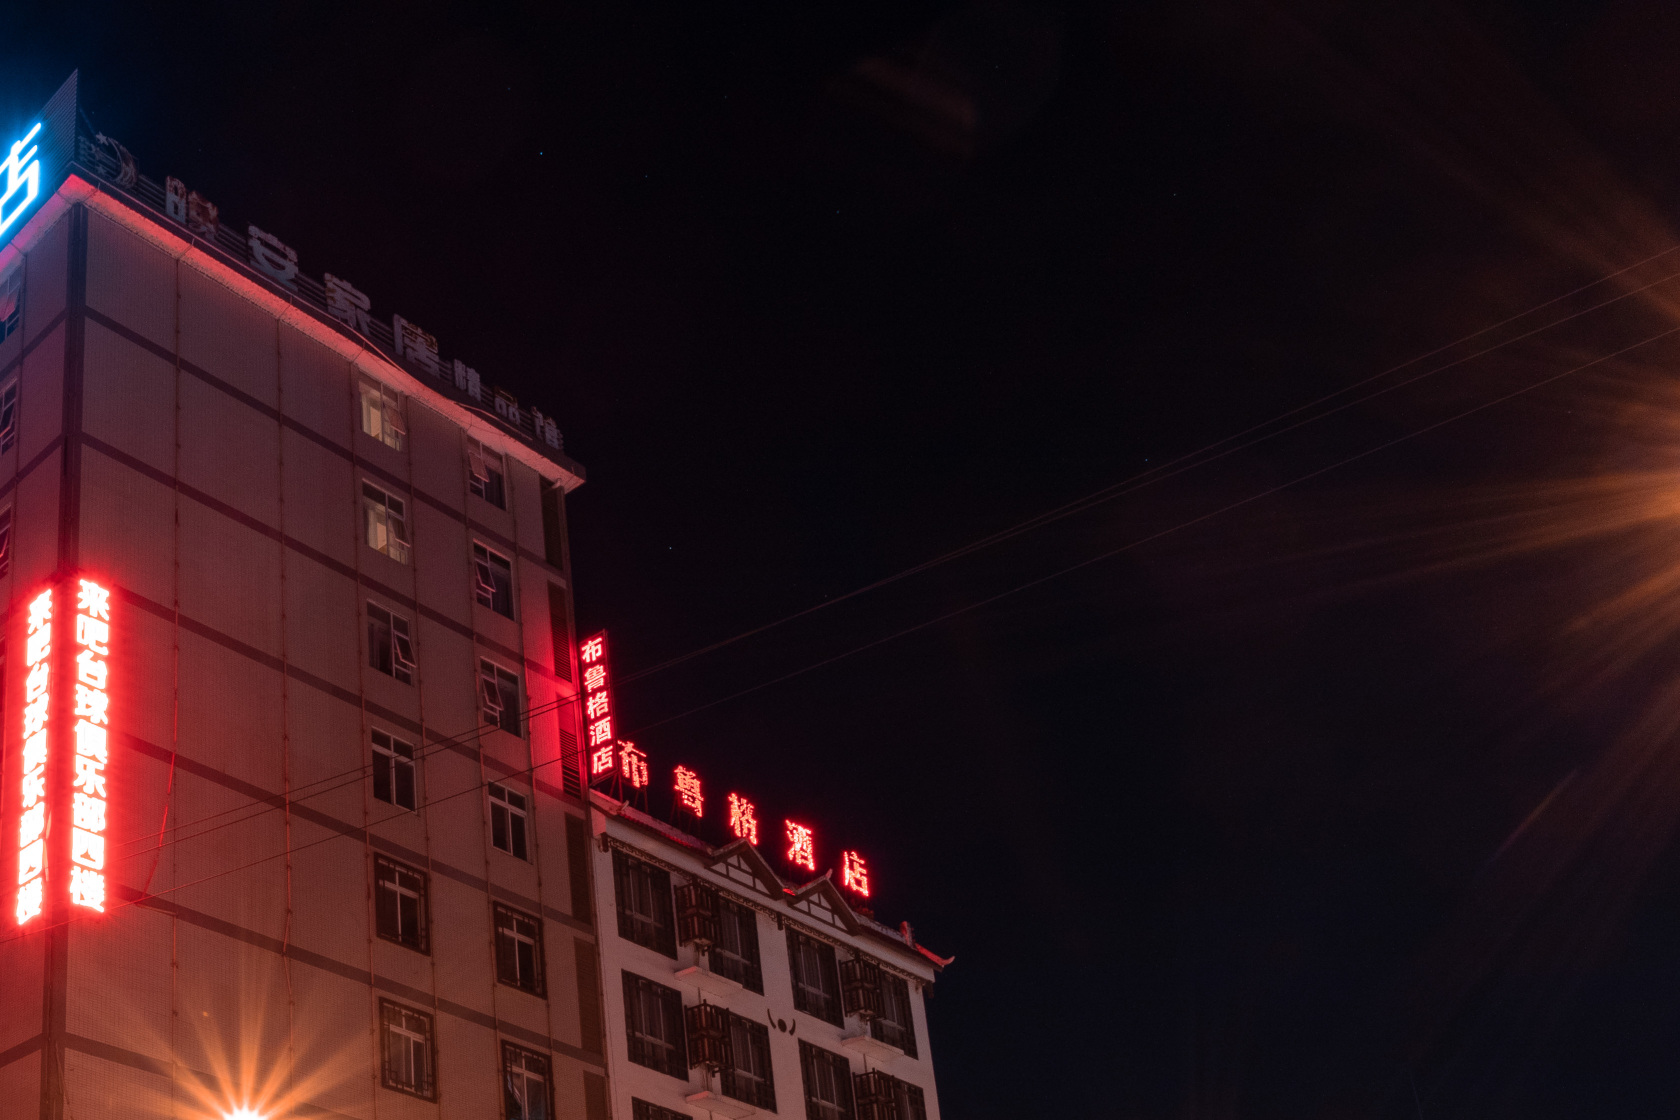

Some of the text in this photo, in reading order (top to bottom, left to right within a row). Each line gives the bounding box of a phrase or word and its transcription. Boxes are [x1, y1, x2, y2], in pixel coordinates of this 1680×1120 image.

[69, 578, 110, 913] 来吧台球俱乐部四楼
[581, 636, 615, 776] 布鲁格酒店
